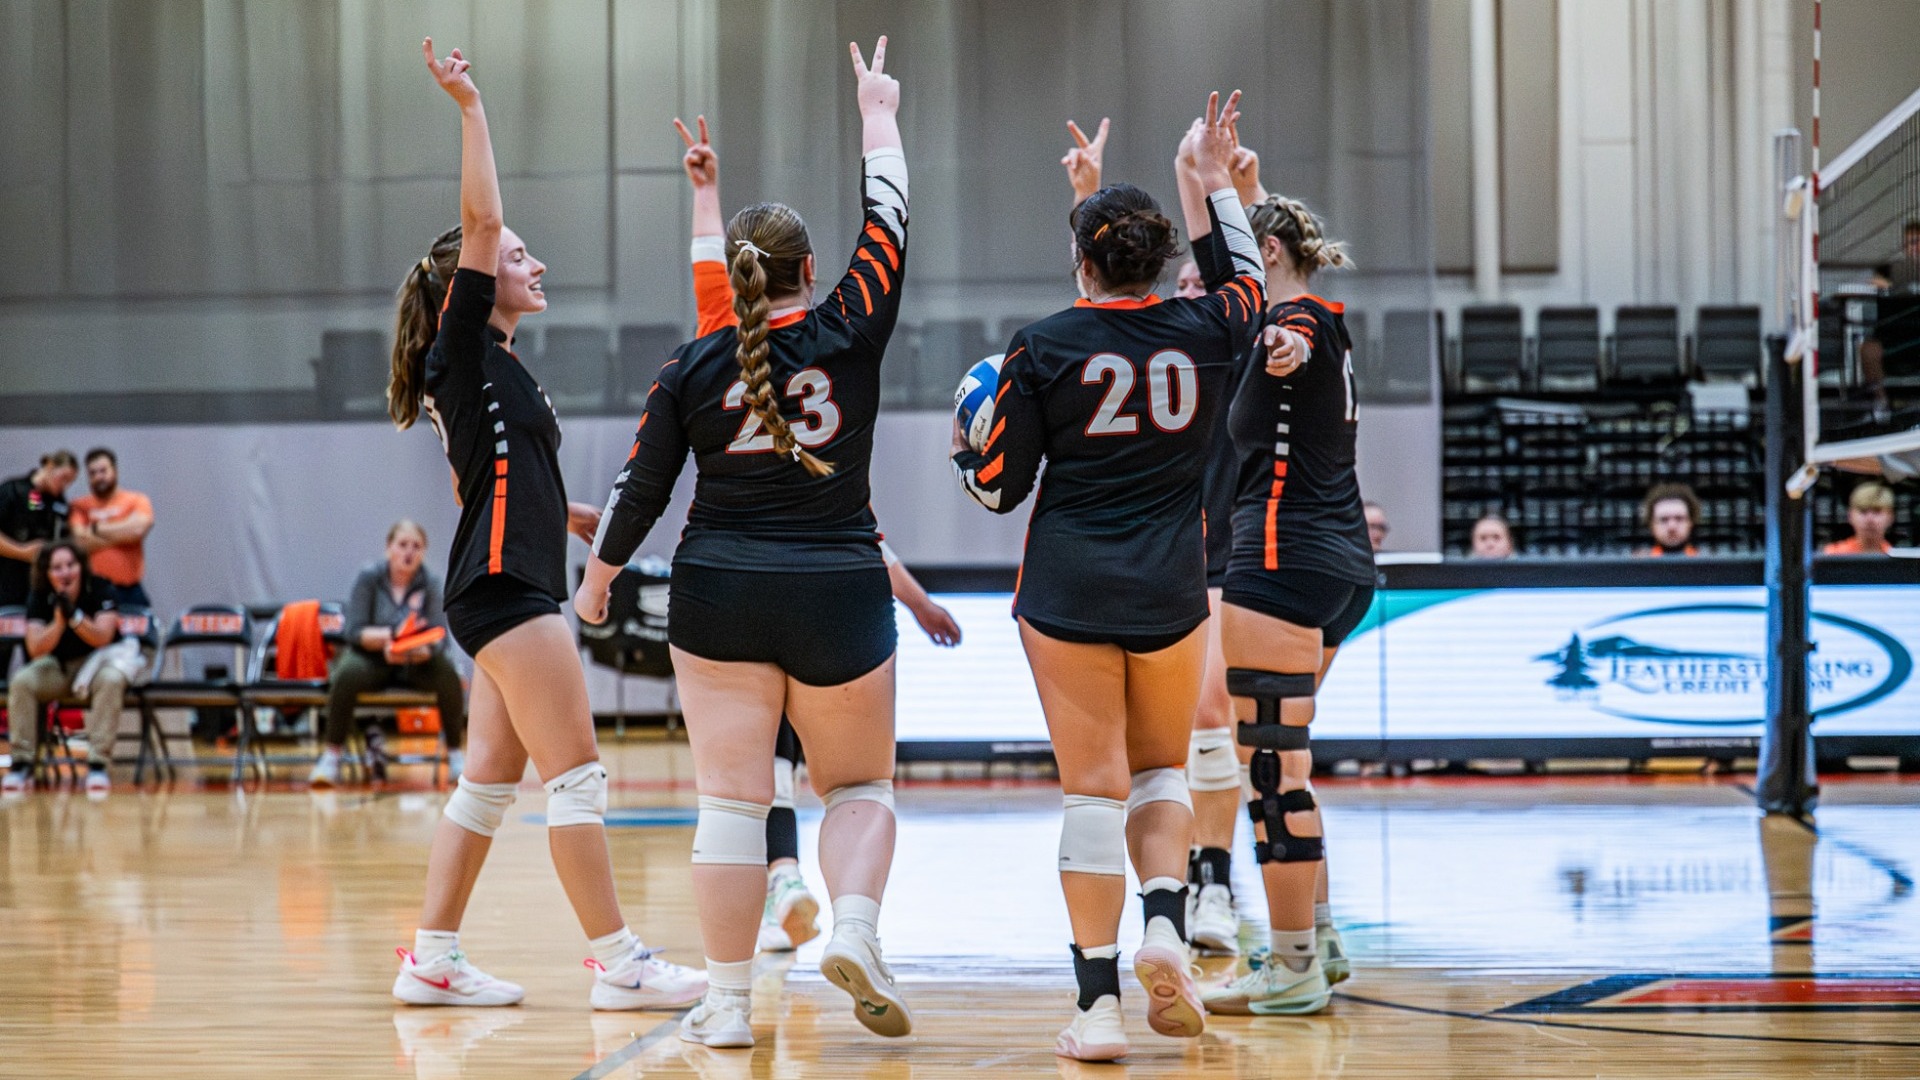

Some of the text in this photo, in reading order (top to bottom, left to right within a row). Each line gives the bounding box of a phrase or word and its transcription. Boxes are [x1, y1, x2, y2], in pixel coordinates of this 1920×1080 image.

[722, 366, 842, 455] 23
[1080, 348, 1199, 437] 20
[1664, 680, 1750, 694] CREDIT
